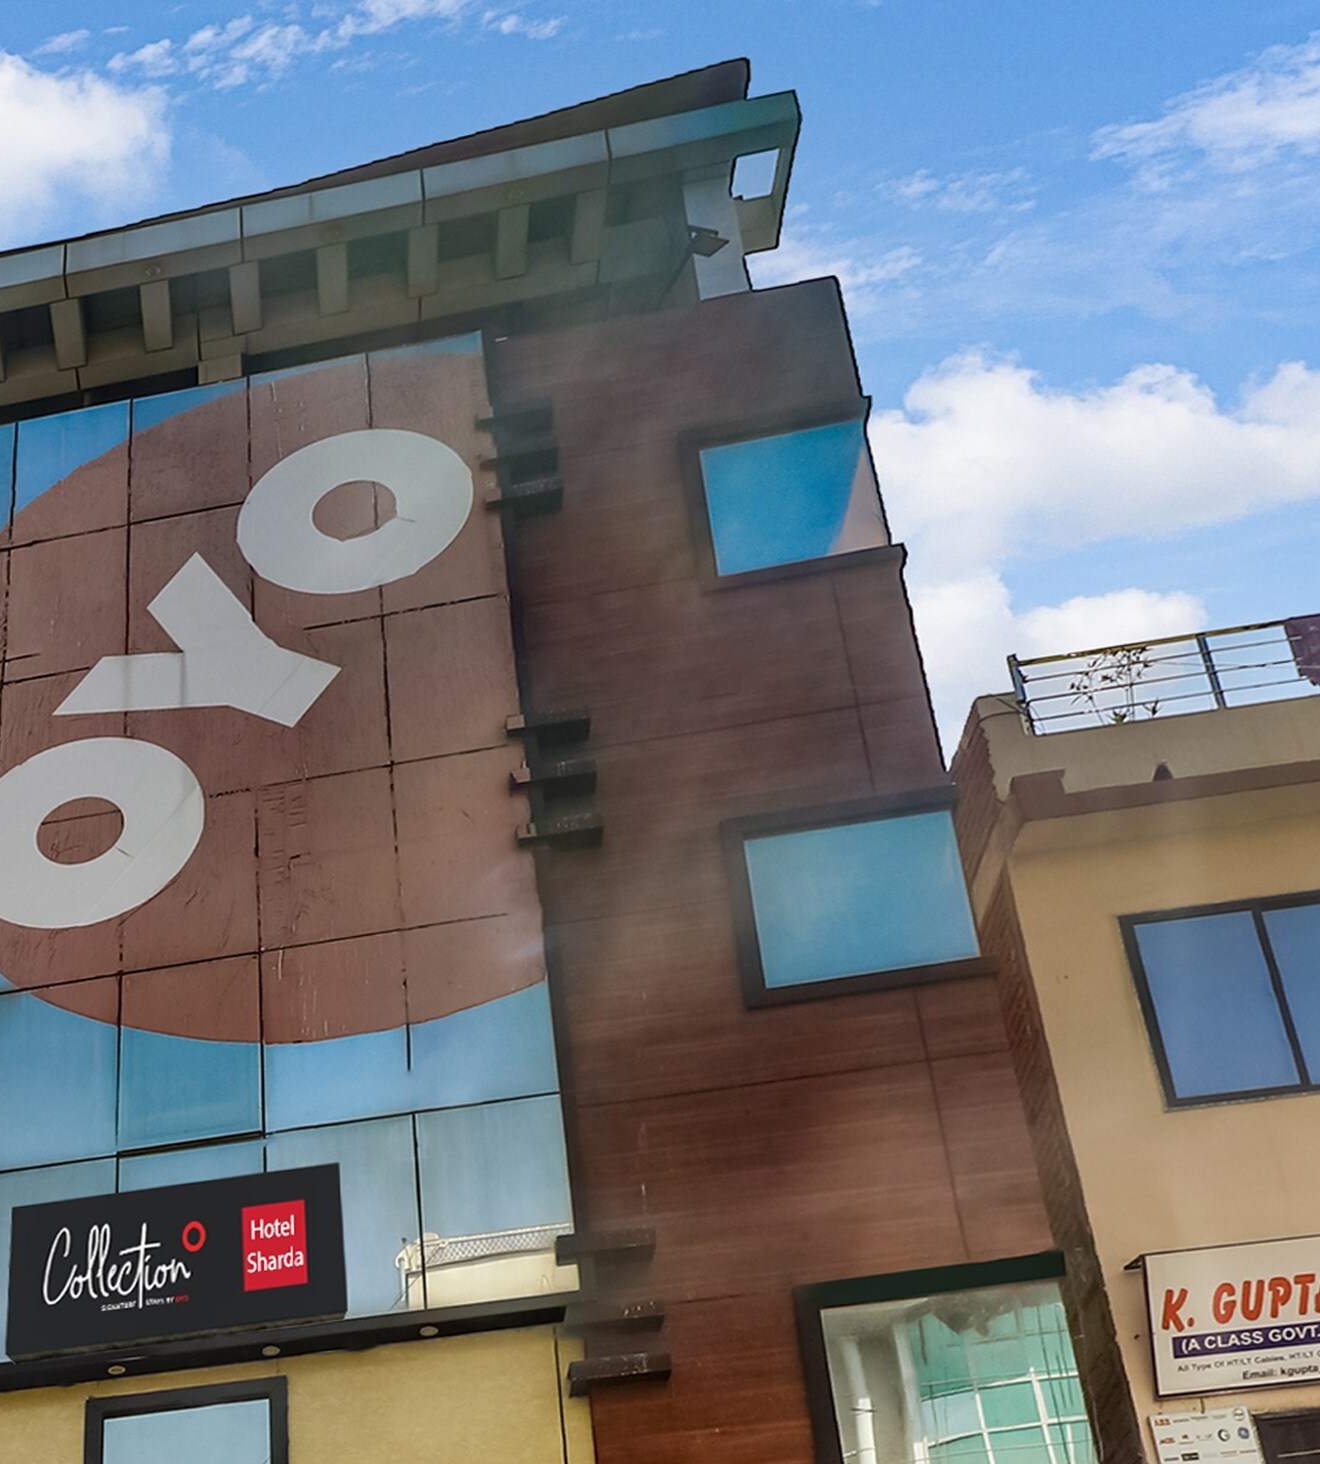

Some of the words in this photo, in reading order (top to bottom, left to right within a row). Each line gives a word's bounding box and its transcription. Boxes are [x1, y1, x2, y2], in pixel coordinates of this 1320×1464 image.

[251, 1214, 295, 1240] Hotel
[43, 1222, 191, 1308] Collection
[246, 1250, 304, 1273] Sharda
[1162, 1288, 1195, 1332] K.
[1182, 1338, 1205, 1355] (A
[1204, 1331, 1263, 1349] CLASS
[1268, 1325, 1320, 1342] GOVT.
[1191, 1363, 1212, 1373] Type
[1242, 1369, 1277, 1381] Email:
